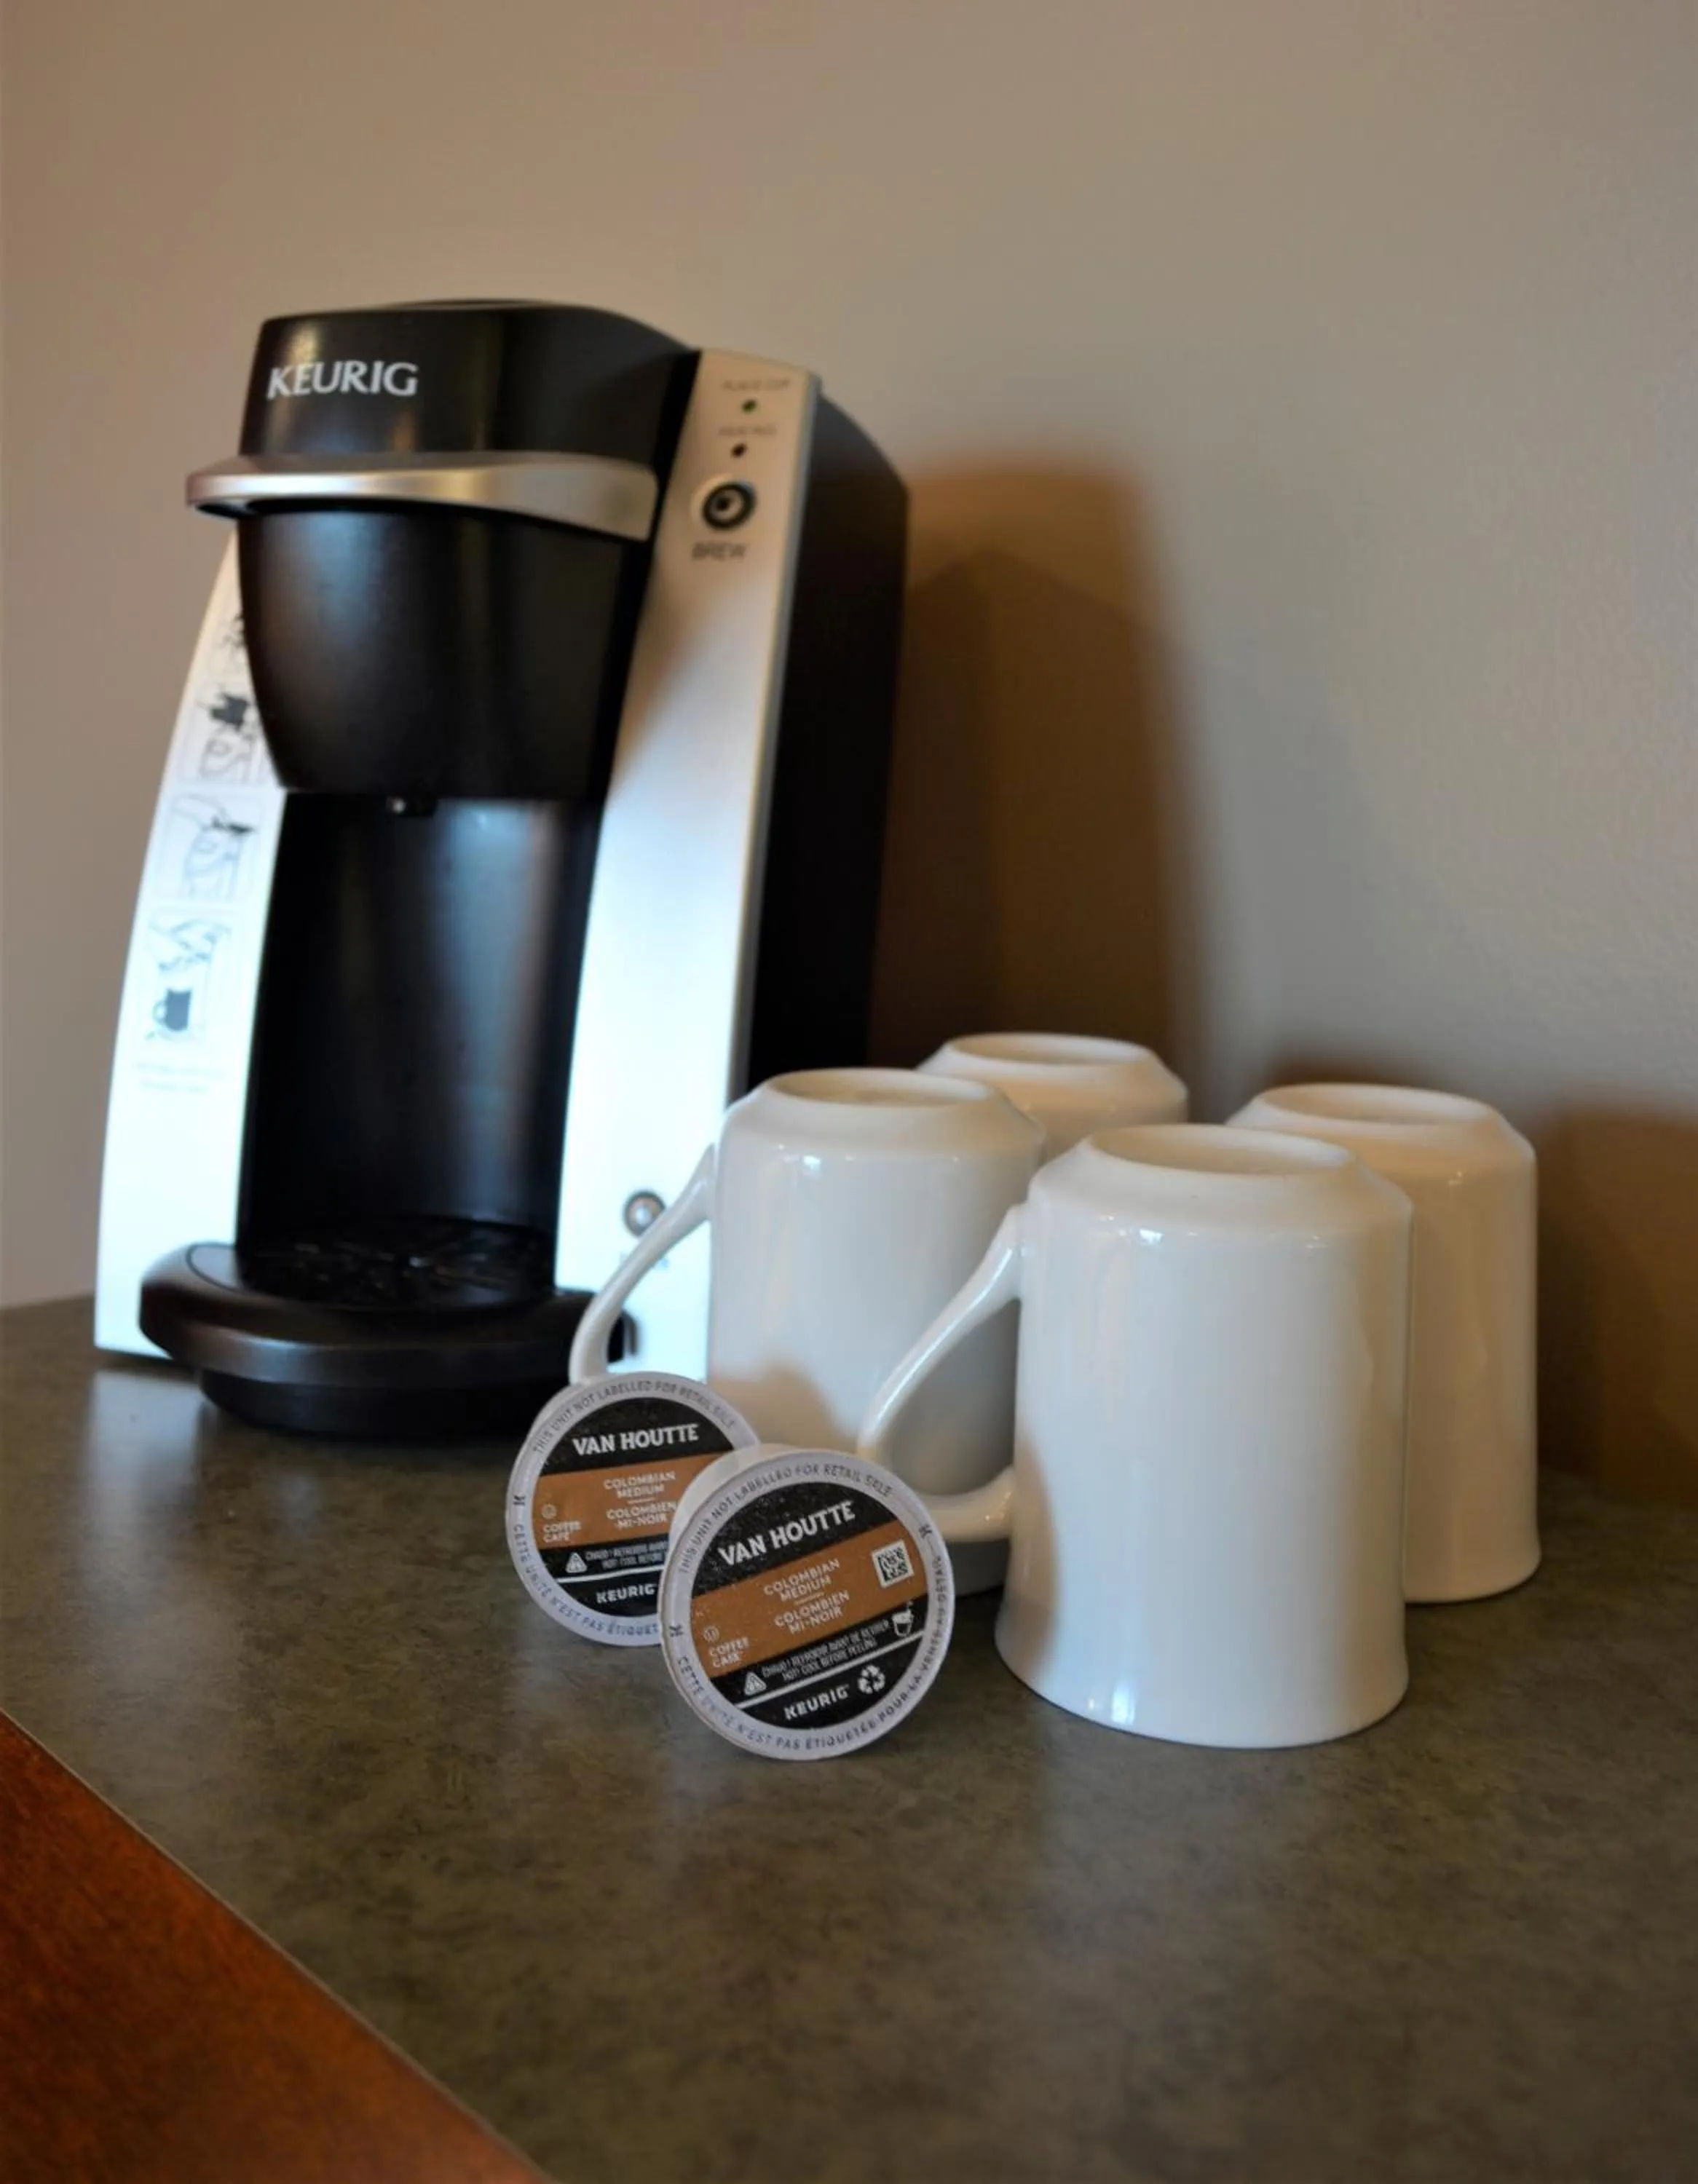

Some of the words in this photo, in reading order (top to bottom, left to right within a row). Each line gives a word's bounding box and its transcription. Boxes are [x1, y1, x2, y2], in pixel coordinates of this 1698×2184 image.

[267, 360, 419, 400] KEURIG
[572, 1433, 615, 1456] VAN
[620, 1423, 699, 1450] HOUTTE
[603, 1471, 676, 1490] COLOMBIAN
[711, 1497, 733, 1520] NOT
[824, 1463, 861, 1482] RETAIL
[716, 1535, 767, 1566] VAN
[768, 1500, 856, 1549] HOUTTE
[596, 1583, 656, 1604] KEURIG
[763, 1558, 840, 1596] COLOMBIAN
[780, 1575, 832, 1602] MEDIUM
[774, 1590, 850, 1627] COLOMBIEN
[775, 1736, 800, 1749] PAS
[877, 1690, 909, 1722] POUR
[783, 1685, 849, 1720] KEURIG
